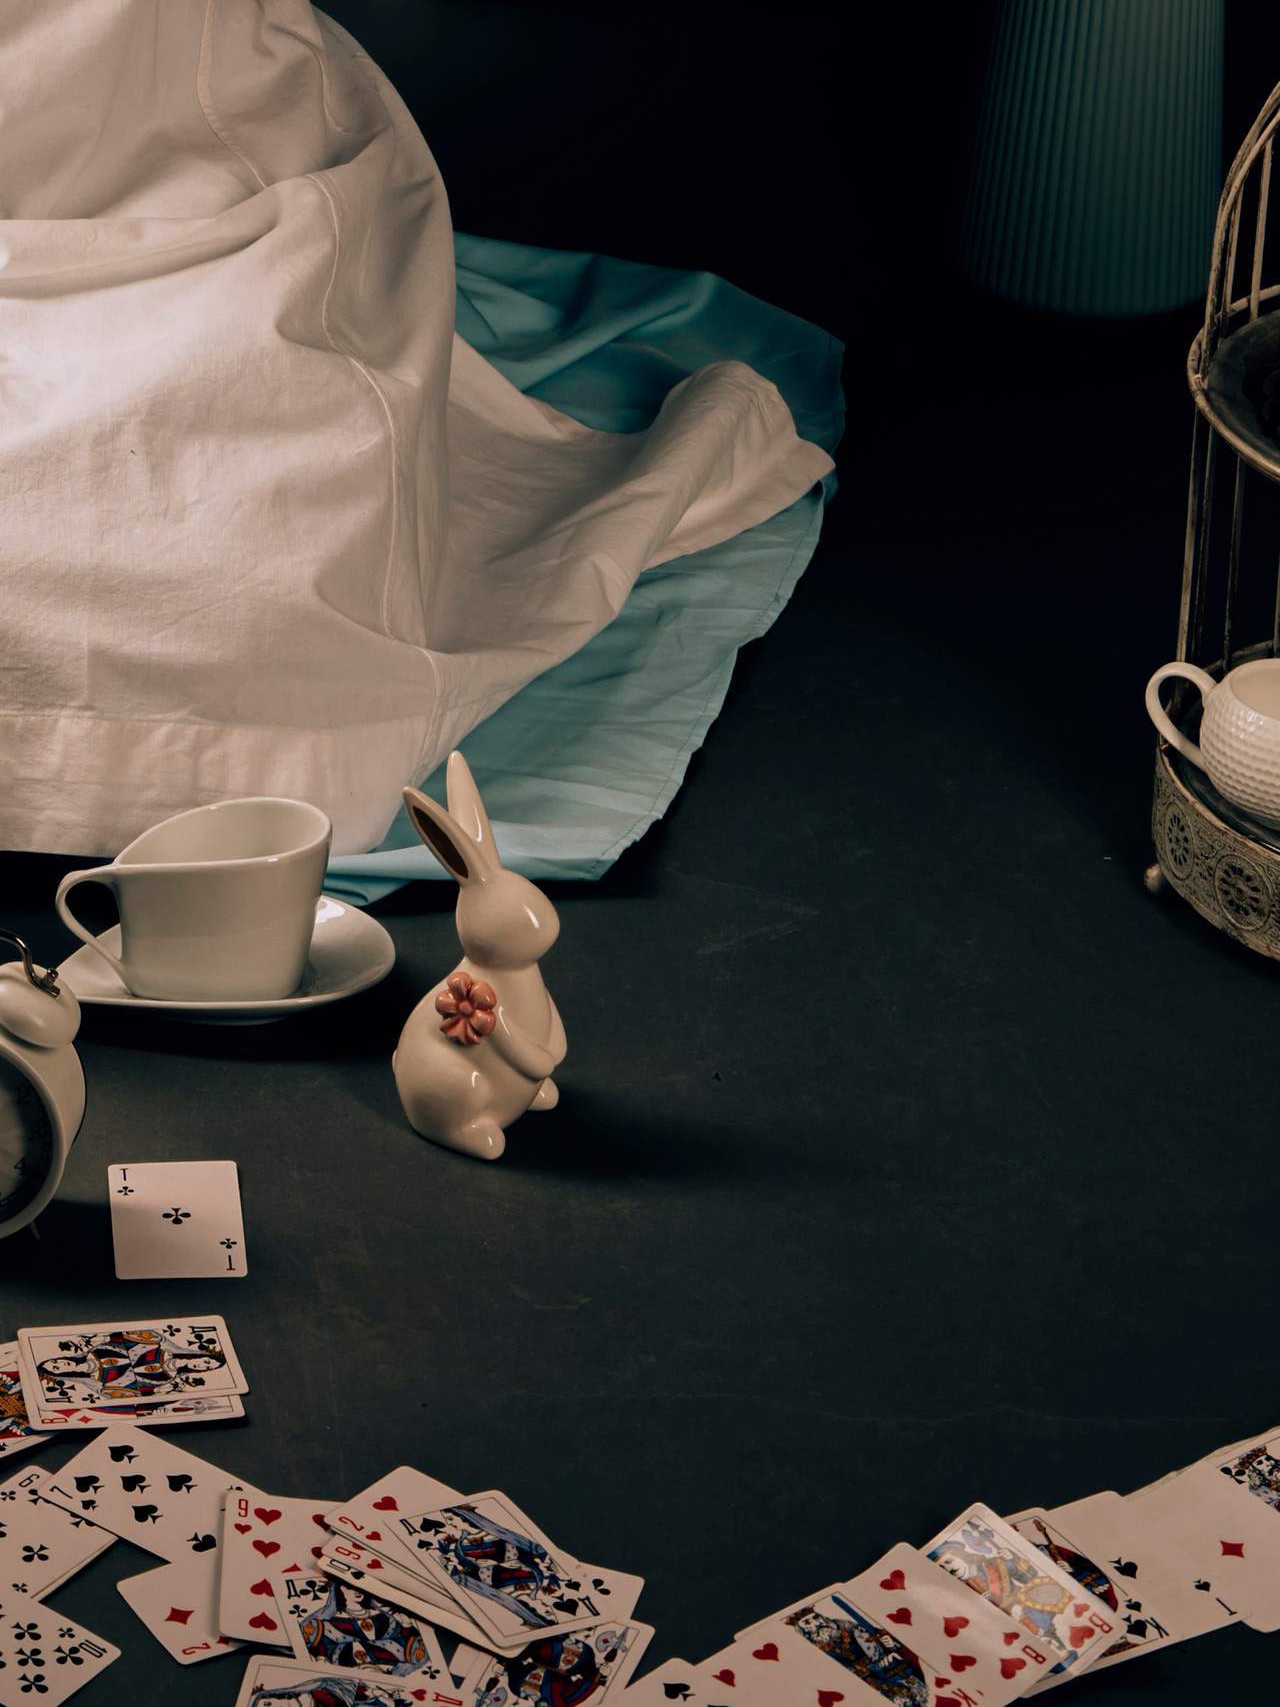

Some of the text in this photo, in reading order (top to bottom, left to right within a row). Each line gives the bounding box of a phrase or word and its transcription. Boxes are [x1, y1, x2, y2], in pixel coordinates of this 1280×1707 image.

[17, 1084, 31, 1105] 2
[29, 1122, 43, 1143] 3
[14, 1156, 27, 1176] 4
[188, 1326, 217, 1334] Д
[18, 1473, 40, 1488] 6
[49, 1486, 73, 1500] 7
[238, 1498, 249, 1517] 9
[338, 1516, 364, 1532] 2
[399, 1518, 421, 1536] Д
[335, 1546, 361, 1561] 9
[326, 1559, 351, 1574] 10
[285, 1579, 301, 1600] Д
[577, 1596, 601, 1616] Д
[78, 1639, 108, 1658] 10
[182, 1642, 211, 1655] 2
[1021, 1645, 1046, 1665] 8
[432, 1692, 463, 1706] Д
